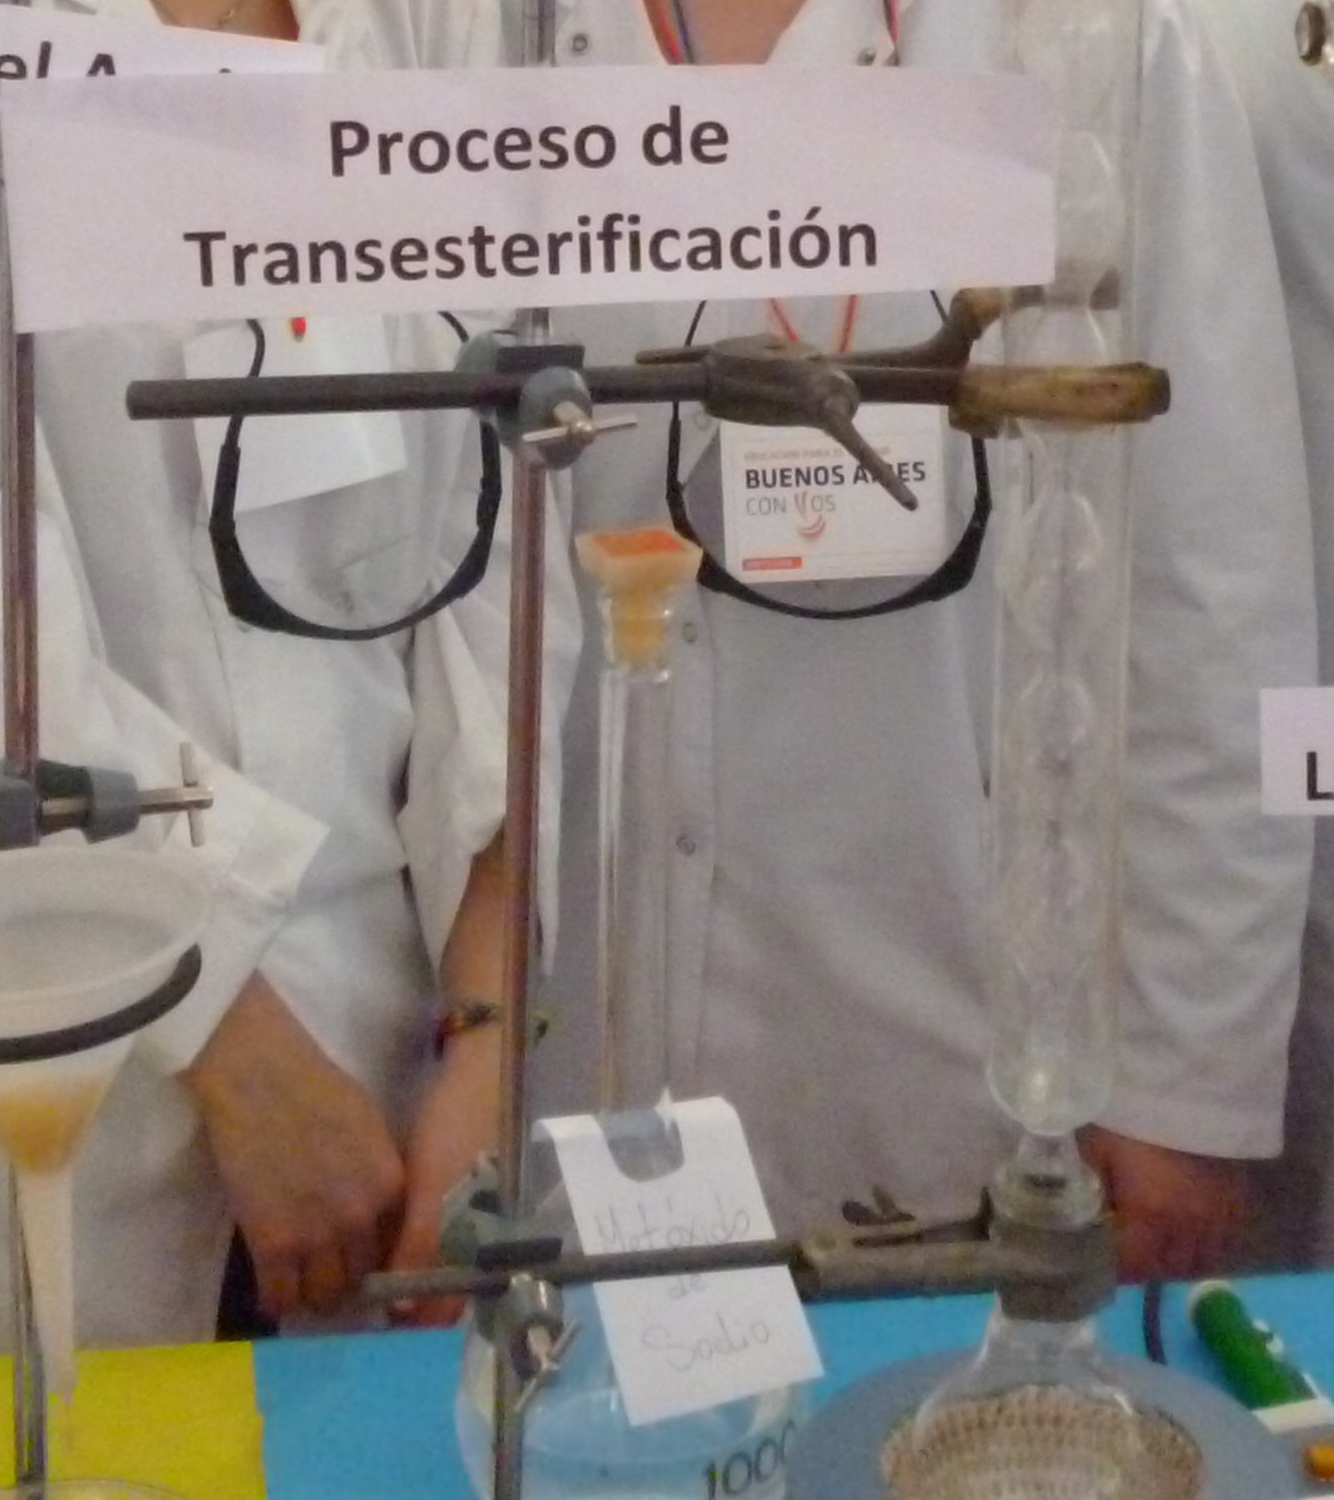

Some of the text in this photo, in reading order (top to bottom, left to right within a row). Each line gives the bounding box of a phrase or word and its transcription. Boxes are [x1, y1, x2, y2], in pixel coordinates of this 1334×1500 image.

[328, 105, 730, 179] Proceso de
[183, 206, 879, 289] Transesterificación
[745, 461, 926, 489] BUENOS AES
[746, 497, 786, 517] CON
